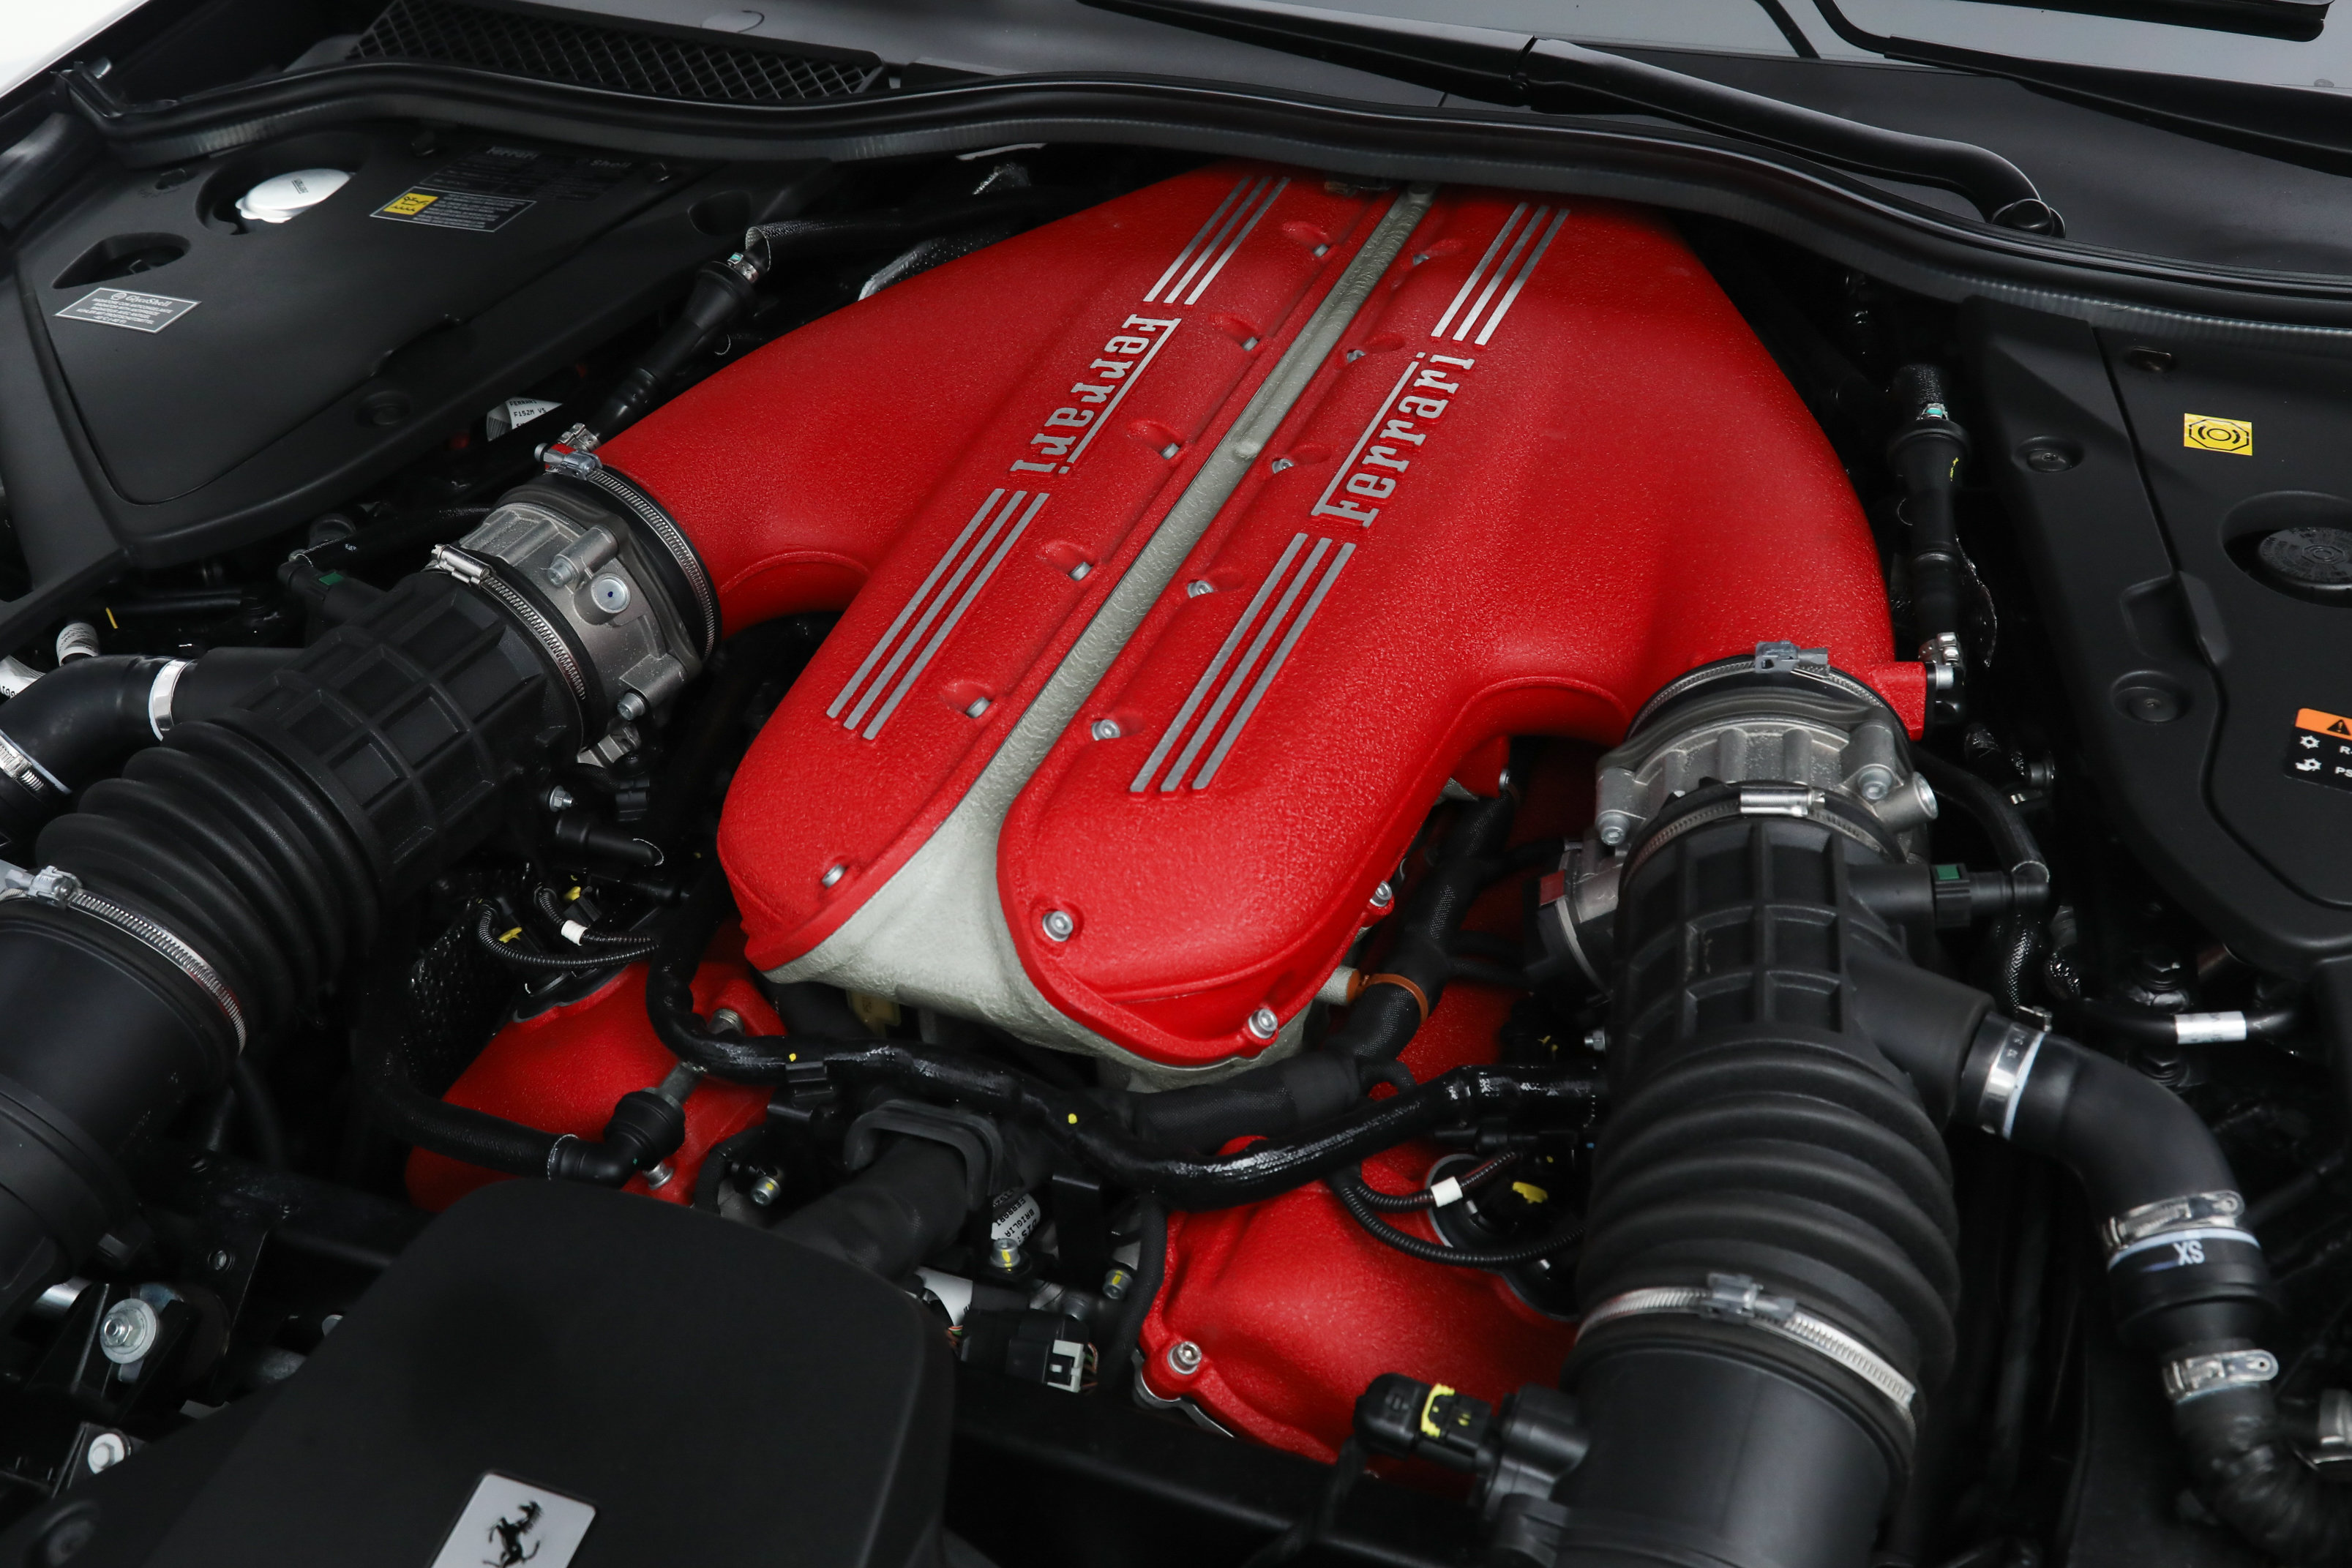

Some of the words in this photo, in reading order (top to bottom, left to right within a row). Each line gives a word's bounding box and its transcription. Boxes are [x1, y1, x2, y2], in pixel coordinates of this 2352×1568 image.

[1009, 313, 1183, 474] Ferrari
[513, 410, 535, 418] F152M
[1311, 352, 1475, 528] Ferrari
[996, 1198, 1027, 1226] FERRARI
[1004, 1208, 1035, 1238] BRIGLIA
